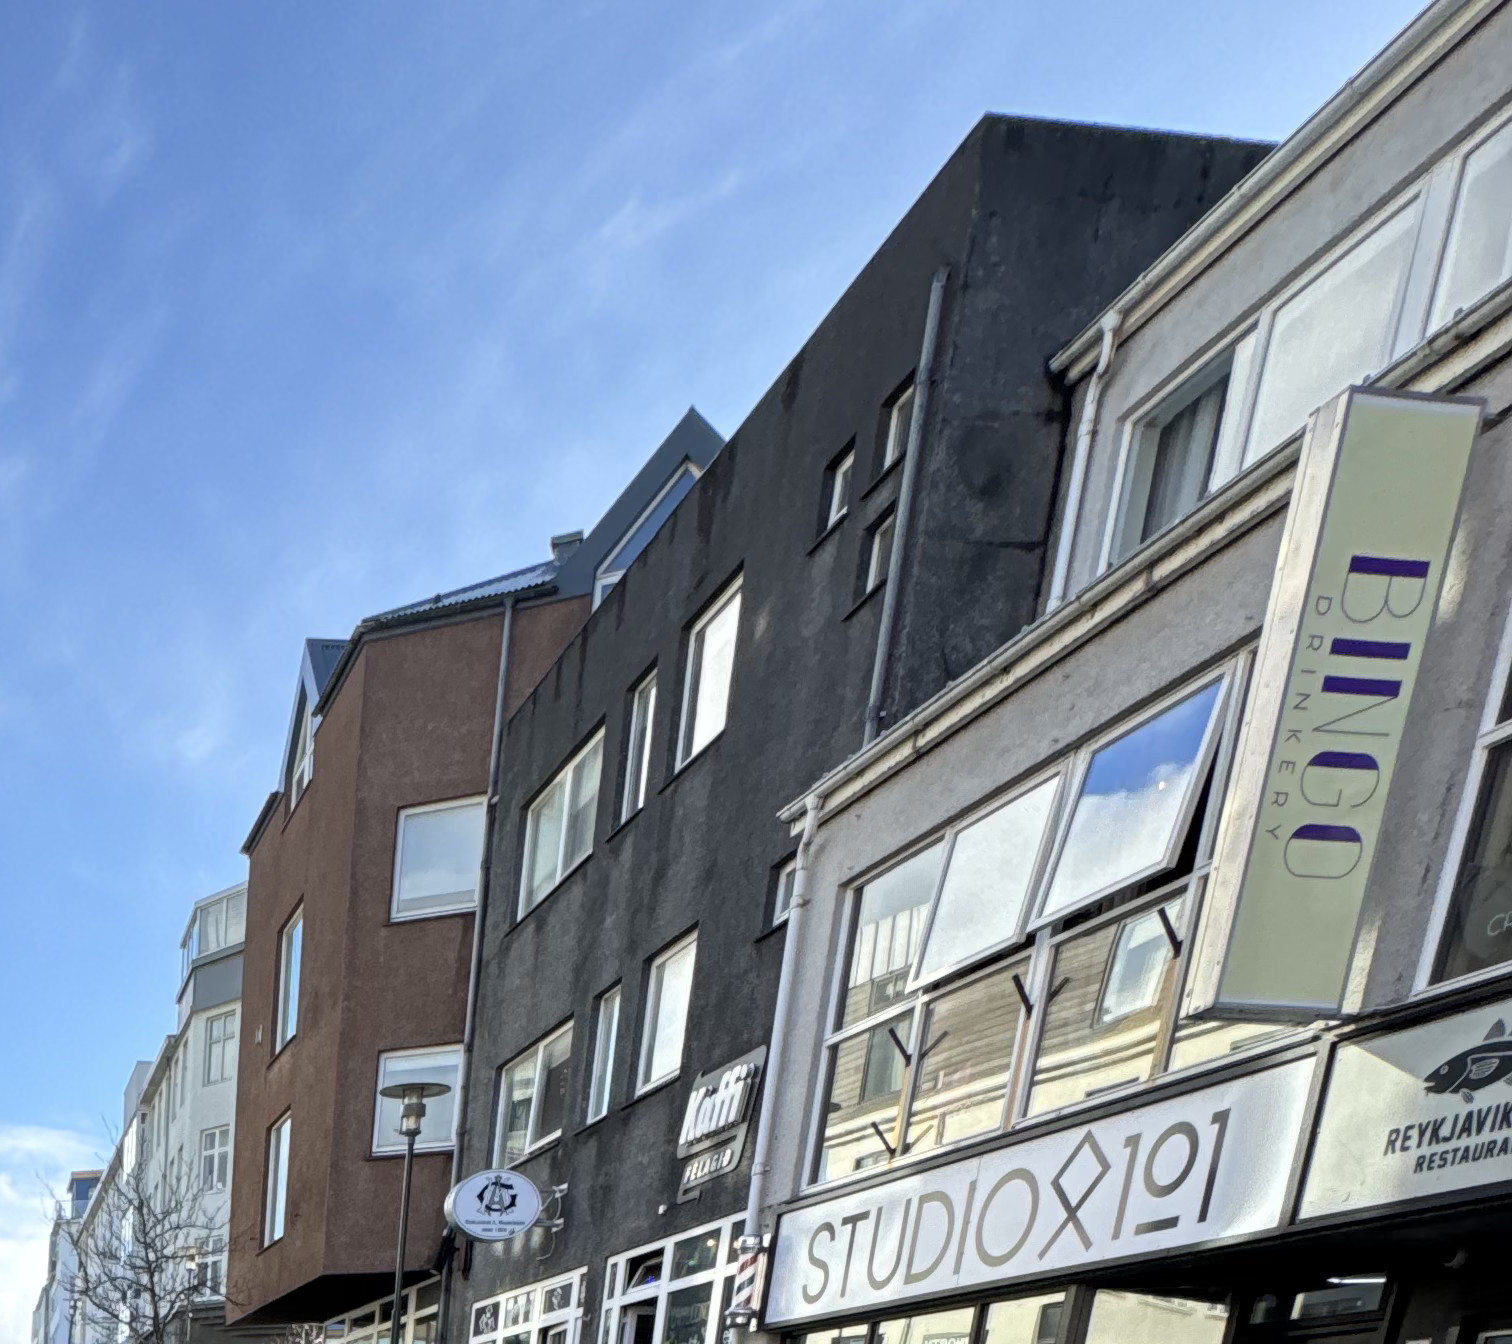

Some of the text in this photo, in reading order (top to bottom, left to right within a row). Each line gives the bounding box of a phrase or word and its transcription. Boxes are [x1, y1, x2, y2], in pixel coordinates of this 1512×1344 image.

[1266, 595, 1333, 840] DRINKERY
[1284, 555, 1431, 879] BINGO
[1383, 1101, 1512, 1157] REYKJAVIK
[1413, 1136, 1512, 1175] RESTAURA
[801, 1167, 1040, 1306] STUDIO
